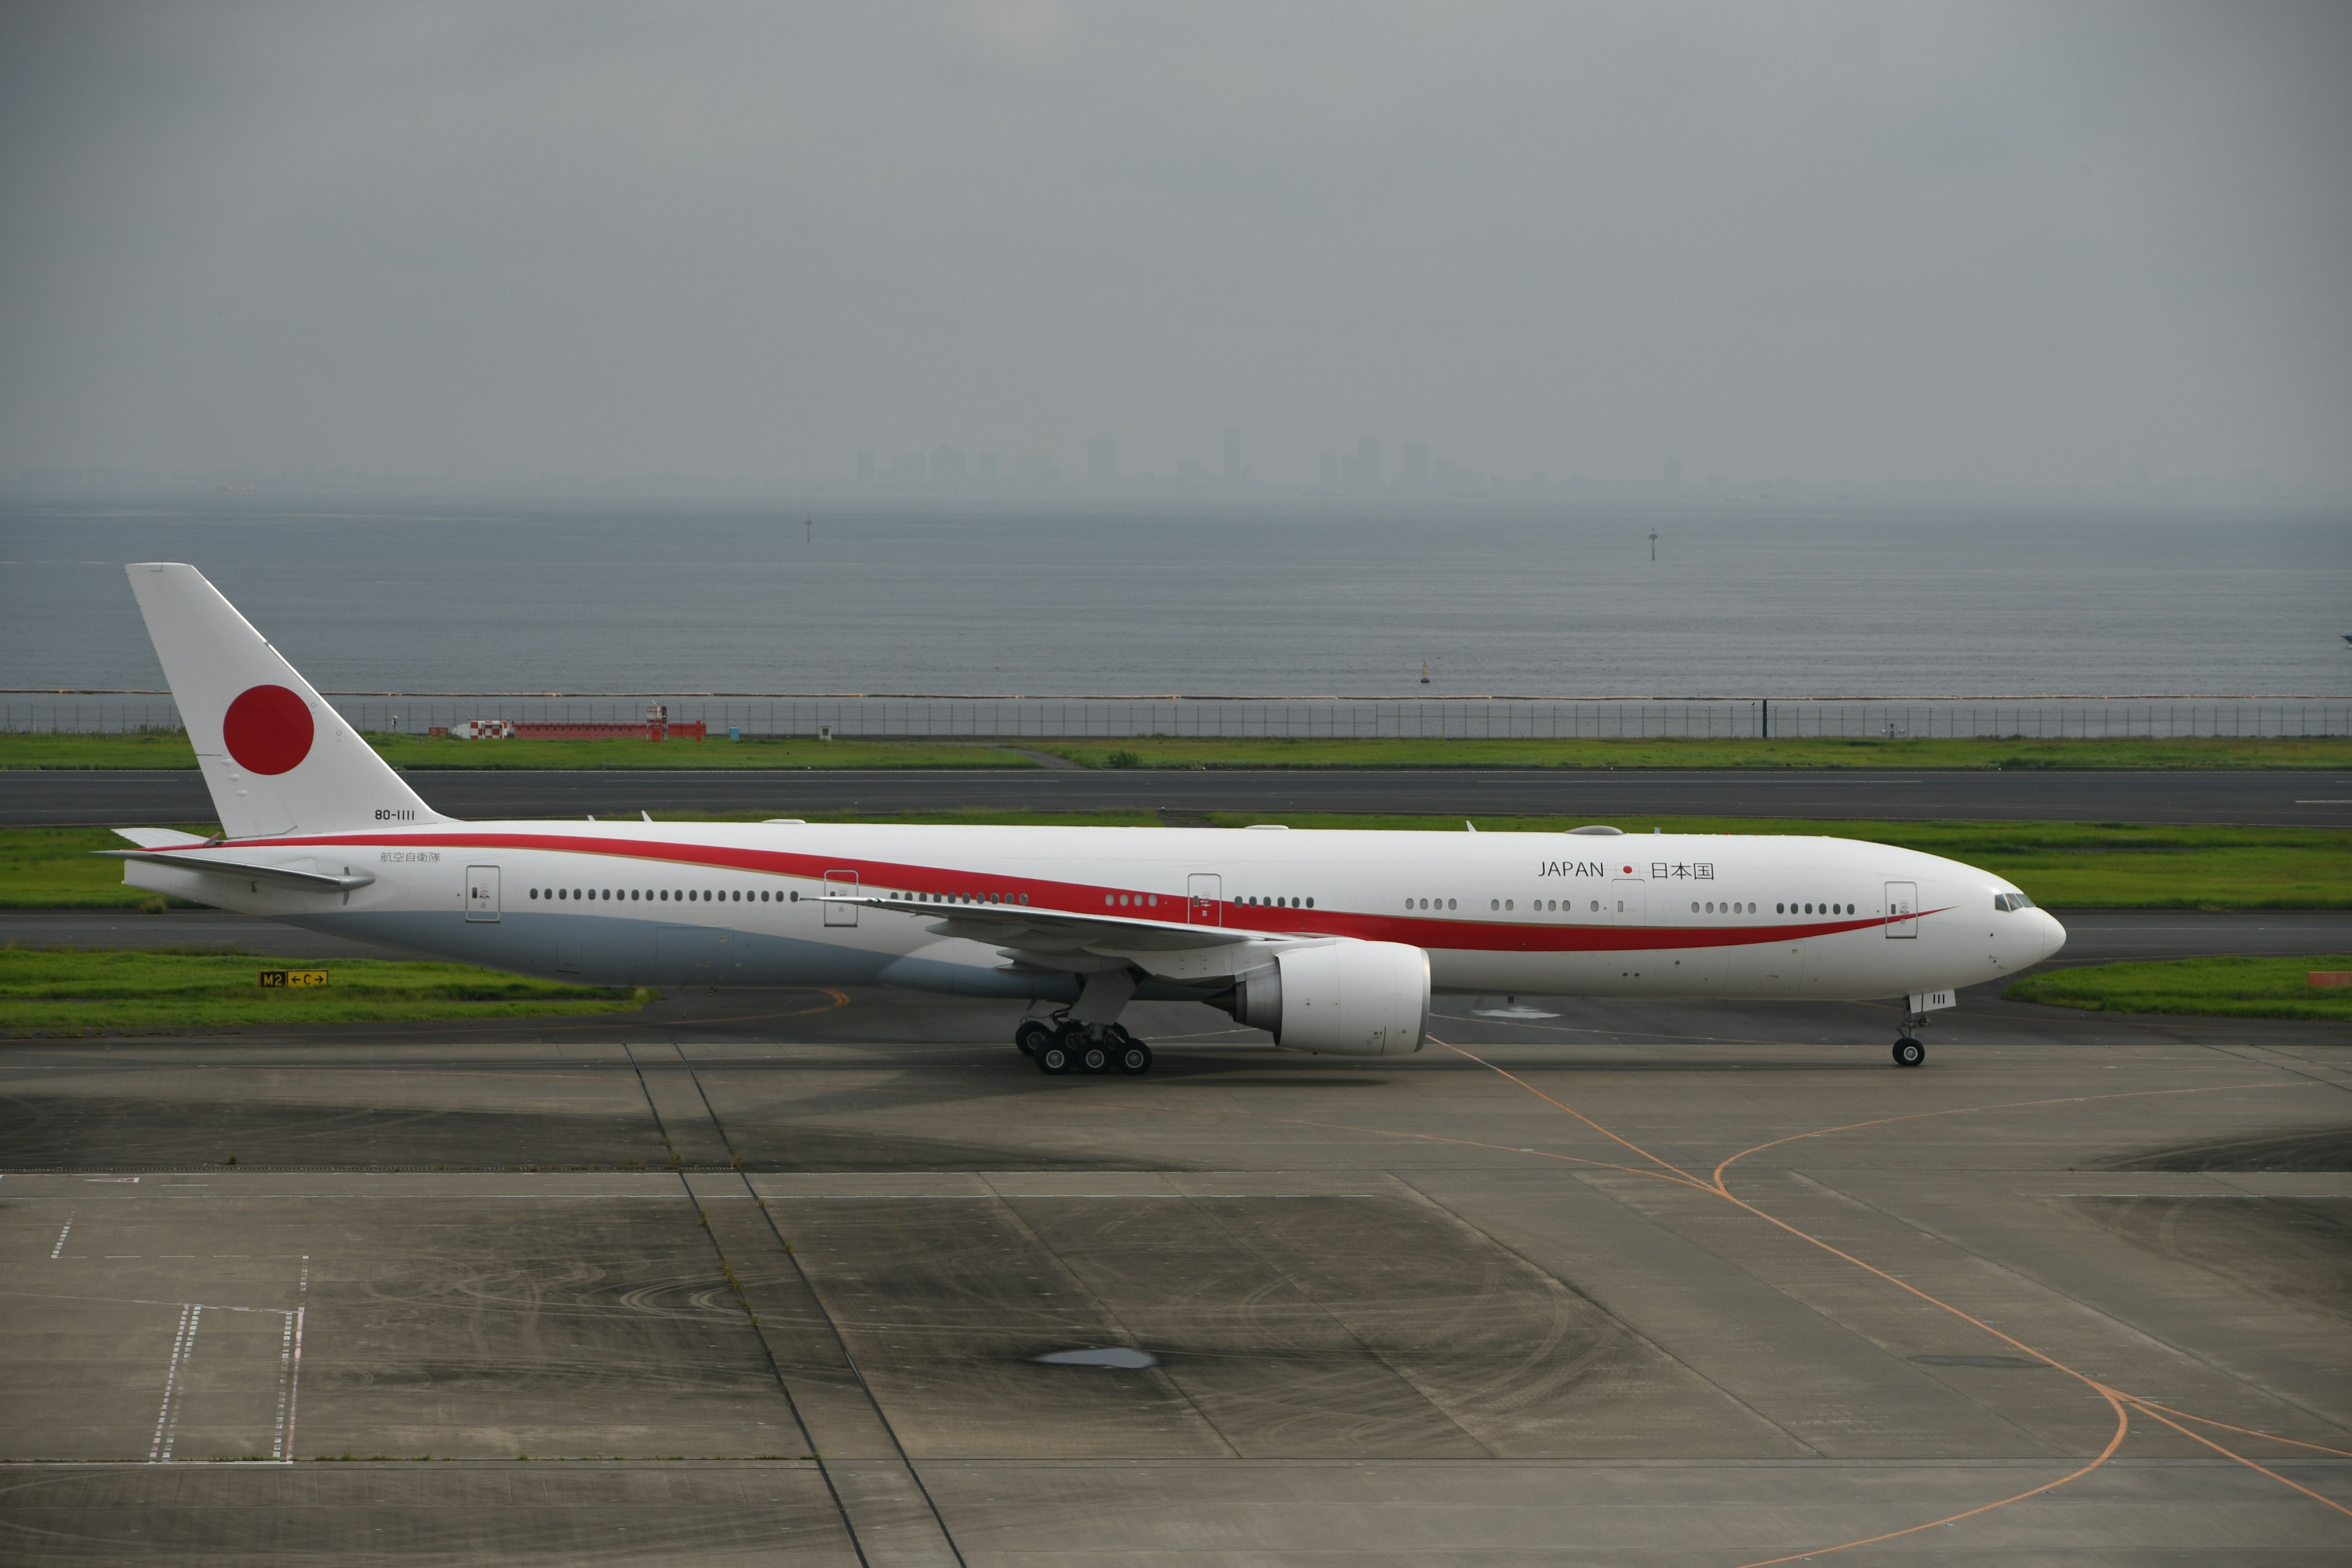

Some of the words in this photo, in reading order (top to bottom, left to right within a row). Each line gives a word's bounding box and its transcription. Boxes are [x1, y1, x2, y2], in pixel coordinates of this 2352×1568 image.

[375, 809, 415, 821] 80-1111
[380, 851, 441, 863] 航空自衛隊
[1537, 861, 1604, 877] JAPAN
[1651, 862, 1714, 880] 日本国
[263, 974, 282, 986] M2
[303, 973, 311, 986] C
[1932, 993, 1945, 1005] 111
